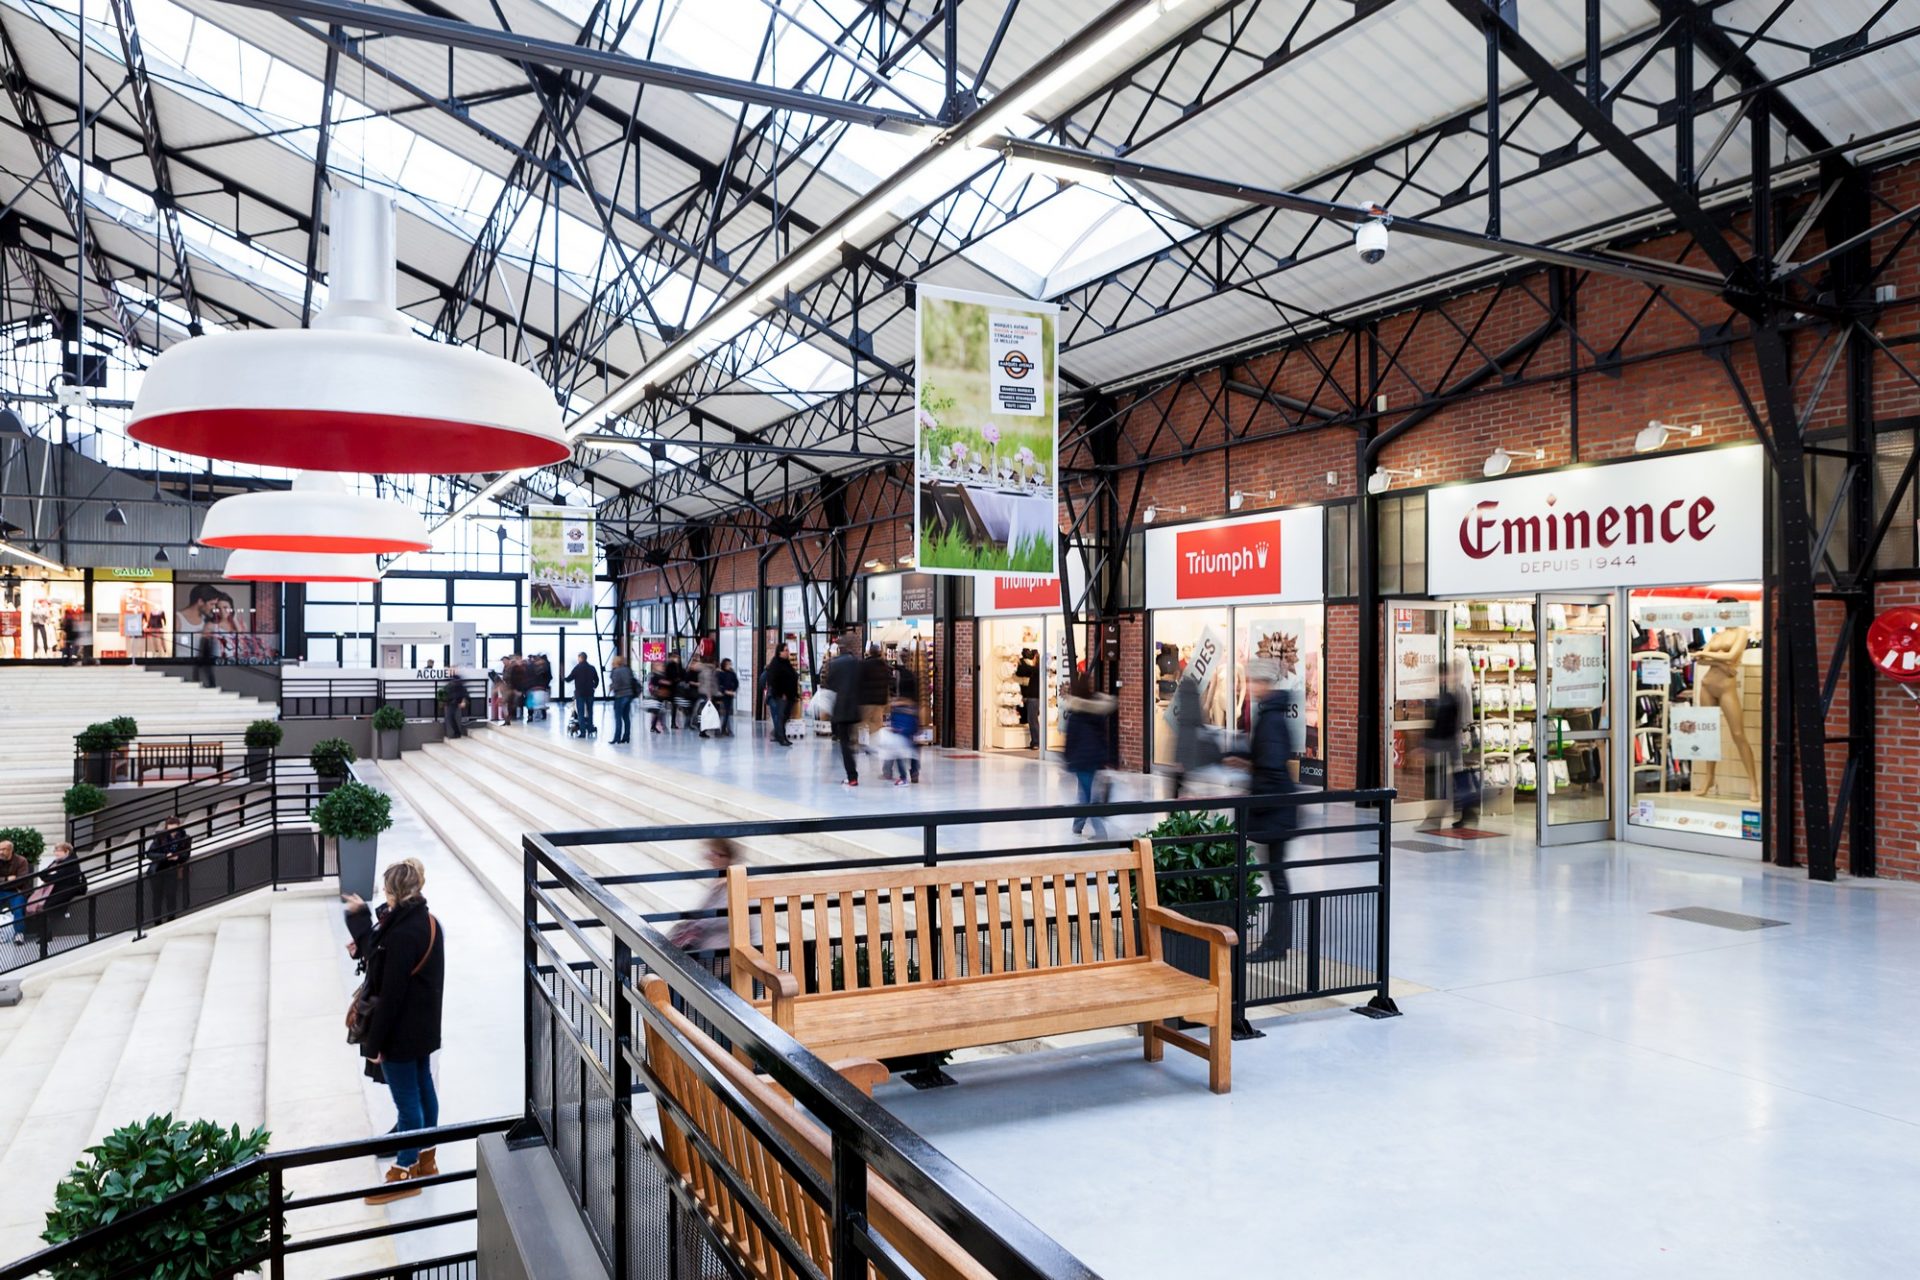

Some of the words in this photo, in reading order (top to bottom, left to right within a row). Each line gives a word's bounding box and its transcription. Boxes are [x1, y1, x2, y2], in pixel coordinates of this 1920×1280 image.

[1459, 494, 1716, 559] Eminence
[1185, 546, 1253, 577] Triumph
[1521, 559, 1580, 573] DEPUIS
[1589, 555, 1637, 569] 1944
